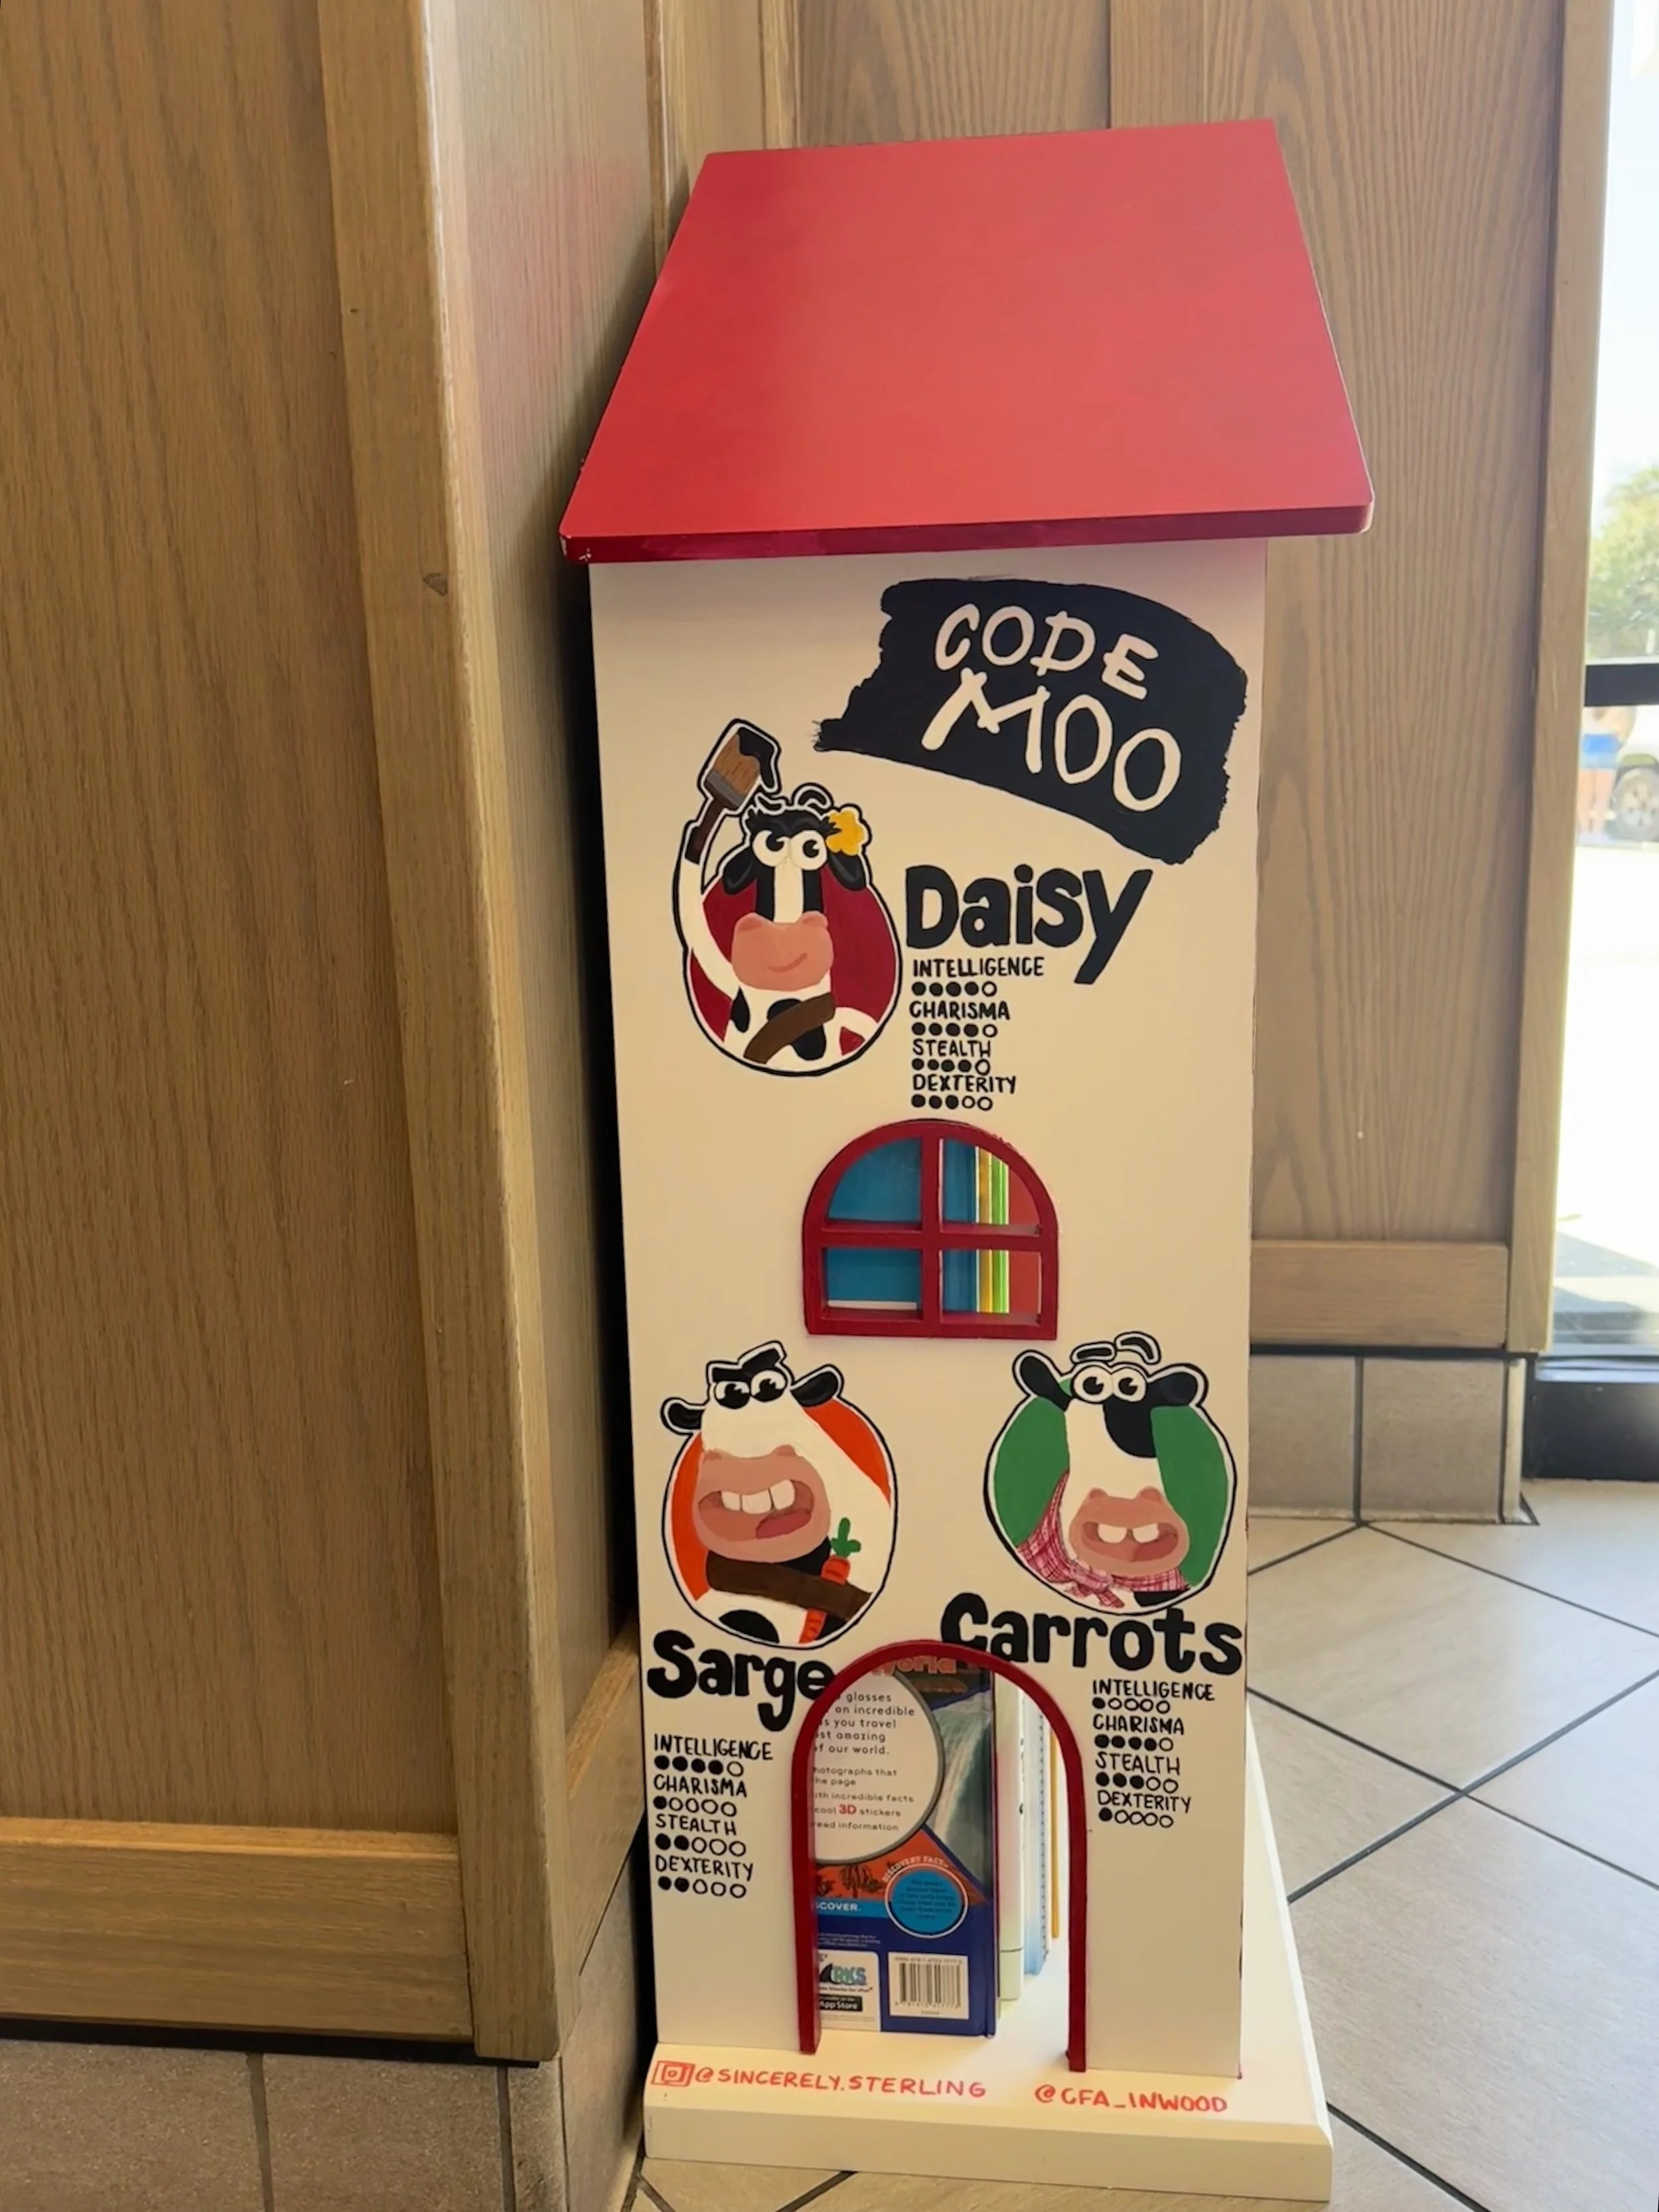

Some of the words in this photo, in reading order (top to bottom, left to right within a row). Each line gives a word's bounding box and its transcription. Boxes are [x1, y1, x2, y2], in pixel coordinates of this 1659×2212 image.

[935, 603, 1159, 700] CODE
[921, 667, 1181, 811] MOO
[905, 864, 1153, 985] Daisy
[912, 956, 1045, 977] INTELLIGENCE
[909, 1001, 1010, 1020] CHARISMA
[912, 1038, 991, 1058] STEALTH
[912, 1074, 1017, 1094] DEXTERITY
[940, 1592, 1242, 1676] Carrots
[647, 1629, 836, 1732] Sarge
[1092, 1678, 1216, 1700] INTELLIGENCE
[846, 1692, 892, 1703] glasses
[854, 1704, 915, 1716] incredible
[834, 1719, 855, 1728] you
[860, 1719, 897, 1728] travel
[1092, 1713, 1185, 1736] CHARISMA
[654, 1734, 774, 1760] INTELLIGENCE
[836, 1732, 886, 1743] amazing
[828, 1745, 848, 1754] our
[853, 1744, 889, 1755] world.
[813, 1767, 873, 1776] hotographs
[1095, 1752, 1181, 1775] STEALTH
[653, 1773, 747, 1797] CHARISMA
[831, 1793, 884, 1801] incredible
[887, 1794, 914, 1803] facts
[839, 1803, 857, 1815] 3D
[1097, 1789, 1192, 1813] DEXTERITY
[655, 1813, 737, 1836] STEALTH
[837, 1821, 900, 1831] information
[655, 1854, 753, 1882] DEXTERITY
[695, 2067, 987, 2099] @SINCERELY.STERLING
[1035, 2083, 1228, 2112] @CFA_INWOOD
